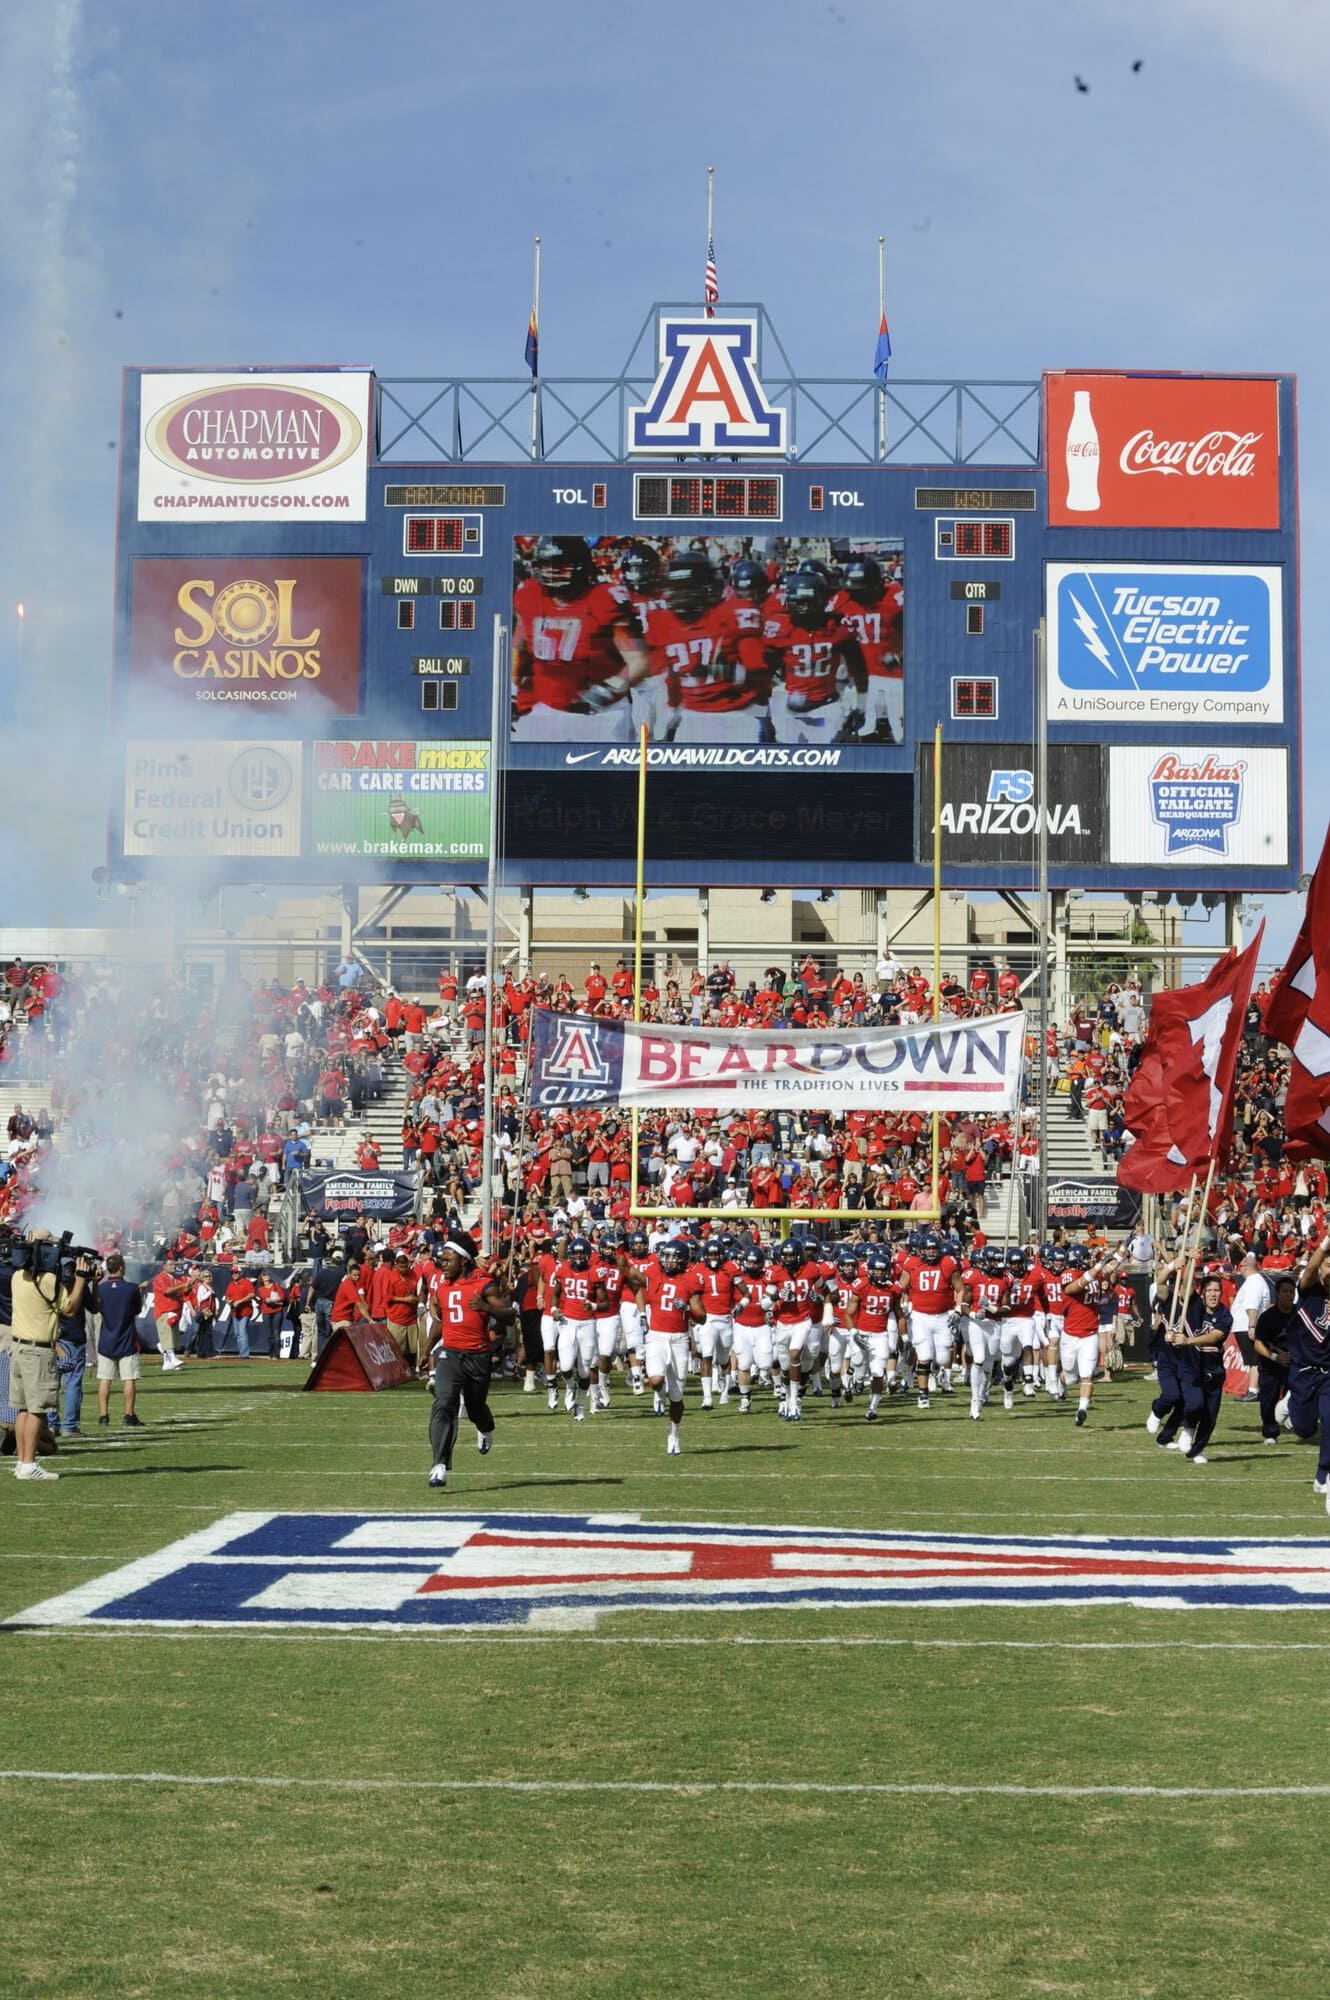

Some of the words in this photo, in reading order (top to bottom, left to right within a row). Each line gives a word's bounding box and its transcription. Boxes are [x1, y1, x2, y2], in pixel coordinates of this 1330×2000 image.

[628, 318, 787, 453] A
[183, 409, 323, 445] CHAPMAN
[187, 447, 320, 460] AUTOMOTIVE
[1119, 430, 1263, 476] Coca-Cola
[153, 495, 350, 508] CHAPMANTUCSON.COM
[405, 487, 485, 505] ARIZONA
[552, 489, 587, 504] TOL
[829, 491, 864, 506] TOL
[394, 579, 418, 593] DWN
[441, 579, 455, 593] TO
[459, 579, 474, 593] GO
[965, 583, 986, 598] QTR
[1112, 587, 1220, 616] Tucson
[174, 579, 320, 647] SOL
[1123, 618, 1250, 645] Electric
[172, 650, 321, 679] CASINOS
[419, 659, 443, 673] BALL
[447, 659, 462, 673] ON
[1136, 646, 1249, 674] Power
[196, 690, 297, 700] SOLCASINOS.COM
[1057, 698, 1069, 710] A
[1072, 698, 1147, 712] UniSource
[1150, 699, 1199, 714] Energy
[1203, 699, 1270, 715] Company
[315, 742, 416, 769] BRAKE
[418, 749, 489, 770] max
[135, 758, 192, 778] Pima
[318, 773, 352, 790] CAR
[359, 773, 403, 790] CARE
[410, 773, 485, 790] CENTERS
[987, 770, 1033, 802] FS
[134, 786, 221, 808] Federal
[1159, 787, 1234, 798] OFFICIAL
[1159, 799, 1234, 810] TAILGATE
[133, 818, 205, 839] Credit
[212, 818, 283, 839] Union
[1172, 828, 1221, 838] ARIZONA
[743, 1079, 768, 1091] THE
[774, 1079, 856, 1092] TRADITION
[860, 1079, 899, 1092] LIVES
[564, 1278, 588, 1300] 26
[919, 1270, 941, 1292] 67
[449, 1290, 464, 1323] 5
[660, 1284, 676, 1311] 2
